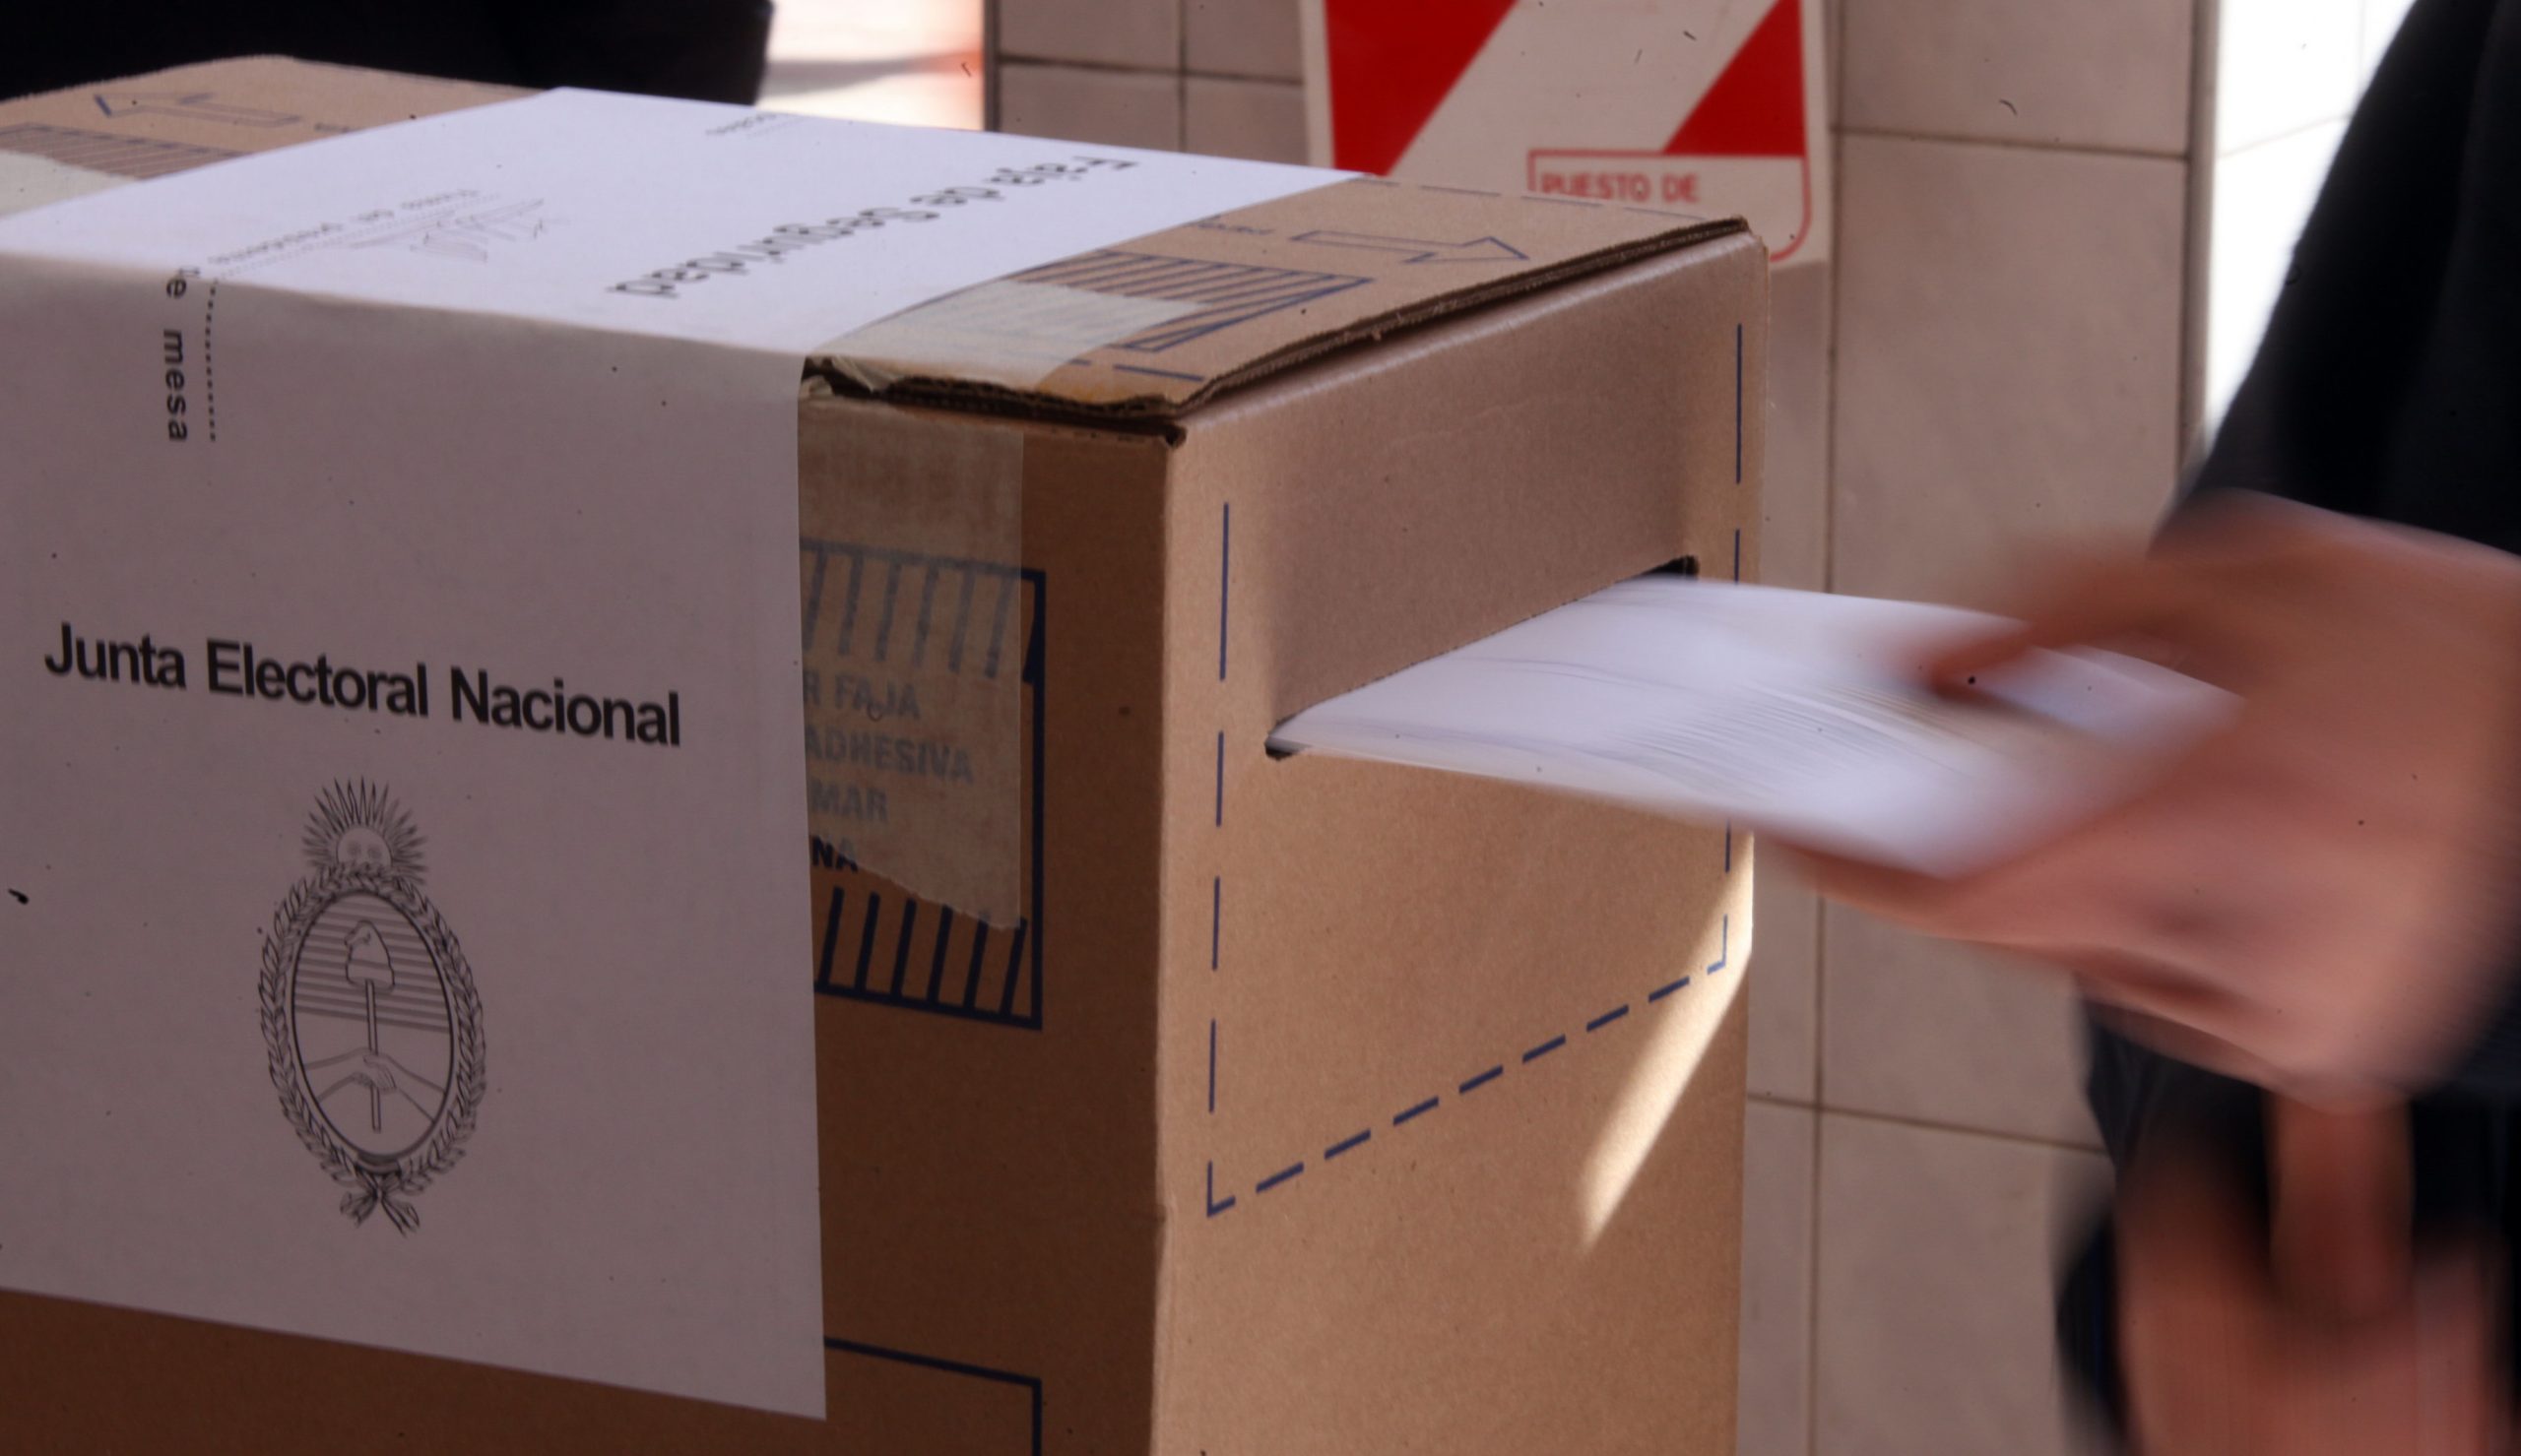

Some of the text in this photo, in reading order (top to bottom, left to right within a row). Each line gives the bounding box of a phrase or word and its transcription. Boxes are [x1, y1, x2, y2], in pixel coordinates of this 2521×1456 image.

[909, 186, 1005, 207] de
[1540, 171, 1702, 203] PUESTO DE
[605, 208, 940, 298] Seguridad
[163, 329, 188, 442] mesa
[44, 621, 681, 748] Junta Electoral Nacional
[834, 673, 922, 721] FAJA
[810, 778, 889, 823] MAR
[811, 835, 860, 873] NA
